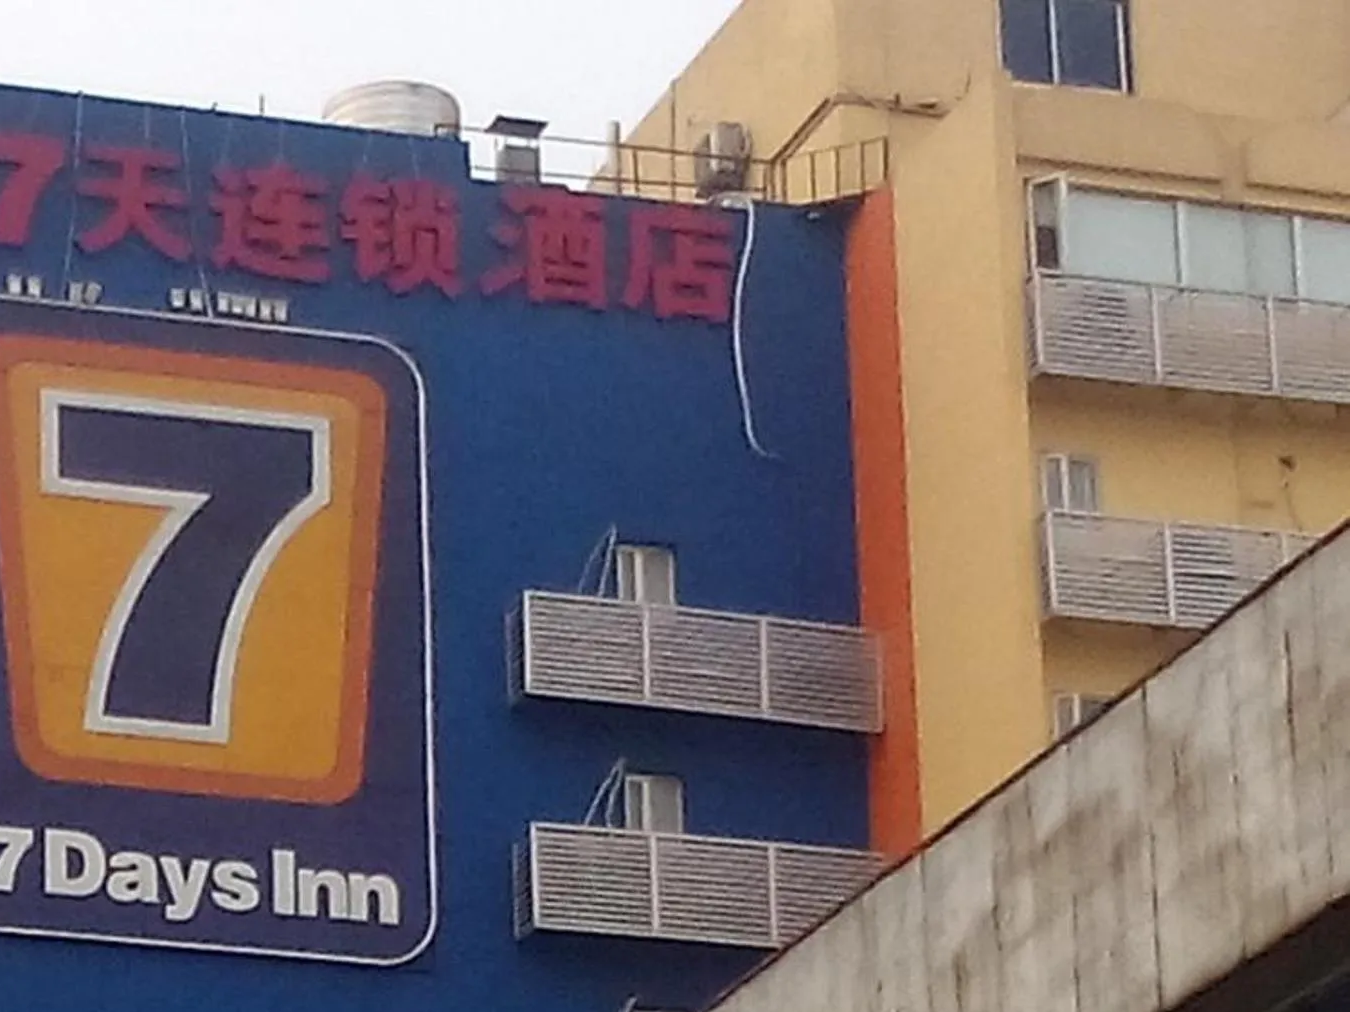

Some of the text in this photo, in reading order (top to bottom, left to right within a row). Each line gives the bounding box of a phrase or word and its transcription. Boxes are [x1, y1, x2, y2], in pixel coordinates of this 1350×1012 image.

[39, 386, 330, 745] 7
[45, 828, 260, 922] Days
[273, 848, 400, 925] Inn
